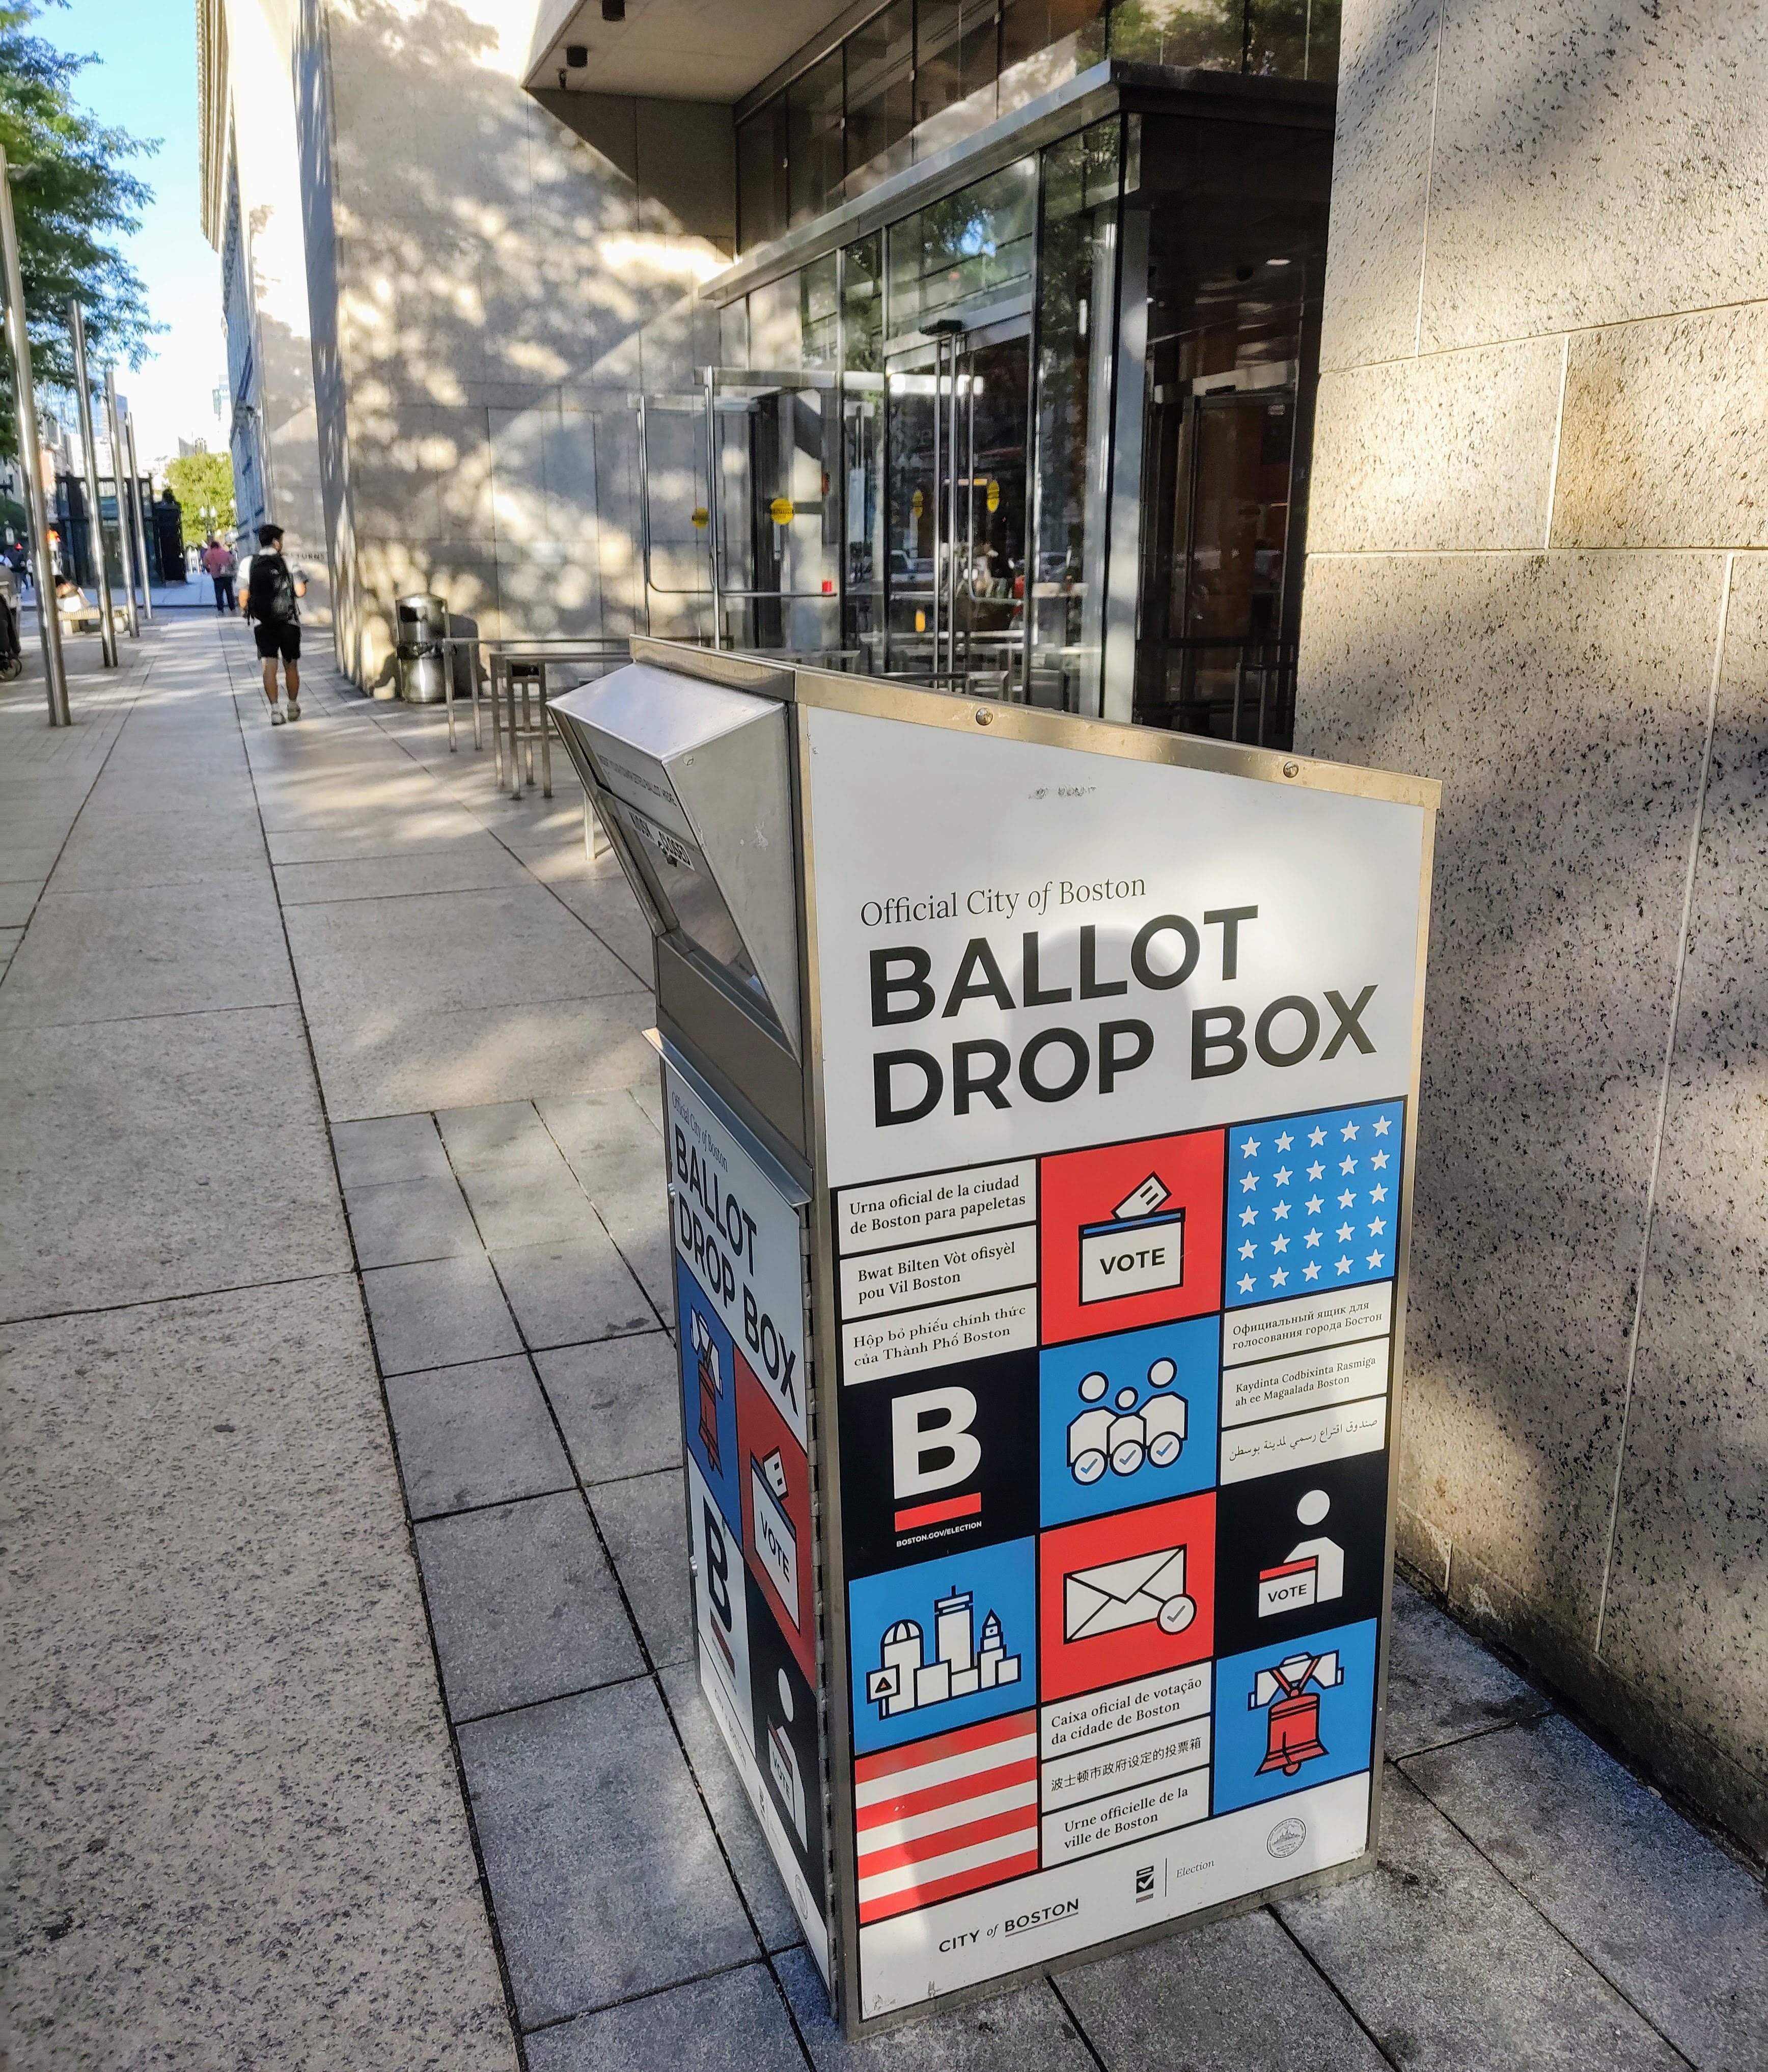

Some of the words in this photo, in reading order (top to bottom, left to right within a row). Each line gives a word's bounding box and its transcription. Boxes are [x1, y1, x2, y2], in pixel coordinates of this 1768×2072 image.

[658, 831, 692, 866] CLOSED
[861, 892, 958, 926] Official
[967, 888, 1020, 919] City
[1028, 881, 1053, 916] of
[1060, 878, 1146, 904] Boston
[869, 904, 1259, 1027] BALLOT
[873, 1018, 1155, 1128] DROP
[1191, 984, 1379, 1081] BOX
[672, 1091, 689, 1125] Official
[690, 1113, 701, 1144] City
[702, 1130, 707, 1152] of
[708, 1134, 728, 1173] Boston
[675, 1123, 757, 1277] BALLOT
[850, 1201, 885, 1215] Urna
[890, 1189, 933, 1209] oficial
[937, 1187, 953, 1200] de
[958, 1184, 970, 1196] la
[974, 1174, 1019, 1194] ciudad
[850, 1221, 867, 1234] de
[872, 1213, 921, 1231] Boston
[925, 1207, 956, 1225] para
[960, 1194, 1026, 1219] papeletas
[858, 1265, 894, 1282] Bwat
[898, 1258, 940, 1275] Bilten
[944, 1251, 967, 1265] Vòt
[971, 1241, 1016, 1261] ofisyèl
[1099, 1247, 1165, 1276] VOTE
[679, 1191, 735, 1310] DROP
[742, 1282, 799, 1418] BOX
[858, 1287, 885, 1305] pou
[889, 1280, 908, 1295] Vil
[913, 1273, 961, 1290] Boston
[853, 1334, 884, 1349] Hộp
[888, 1327, 905, 1341] bỏ
[909, 1317, 949, 1340] phiếu
[953, 1312, 990, 1328] chính
[994, 1305, 1026, 1320] thức
[1232, 1330, 1303, 1350] голосования
[1306, 1322, 1342, 1337] города
[1345, 1313, 1383, 1327] Бостон
[1233, 1310, 1314, 1336] Официальный
[1317, 1306, 1346, 1319] ящик
[1349, 1302, 1370, 1313] для
[854, 1352, 879, 1367] của
[883, 1340, 928, 1361] Thành
[932, 1332, 959, 1350] Phố
[963, 1328, 1011, 1344] Boston
[1235, 1396, 1247, 1406] ah
[1250, 1395, 1261, 1403] ee
[1264, 1383, 1314, 1400] Magaalada
[1317, 1376, 1350, 1389] Boston
[1236, 1376, 1279, 1393] Kaydinta
[1282, 1367, 1334, 1383] Codbixinta
[1337, 1357, 1376, 1372] Rasmiga
[892, 1386, 982, 1500] B
[1290, 1434, 1317, 1450] رسمي
[1319, 1424, 1343, 1443] اقتراع
[1346, 1419, 1378, 1433] صندوق
[760, 1510, 790, 1584] VOTE
[896, 1521, 982, 1548] BOSTON.GOV/ELECTION
[703, 1495, 732, 1633] B
[1268, 1584, 1307, 1603] VOTE
[1052, 1711, 1087, 1728] Caixa
[1091, 1696, 1130, 1717] oficial
[1135, 1692, 1150, 1705] de
[1153, 1678, 1202, 1699] votação
[1052, 1733, 1066, 1745] da
[1070, 1720, 1113, 1739] cidade
[1117, 1714, 1132, 1726] de
[1137, 1701, 1180, 1721] Boston
[772, 1751, 791, 1802] VOTE
[1051, 1736, 1202, 1792] 波士顿市政府设定的投票箱
[1064, 1815, 1097, 1833] Urne
[1100, 1797, 1156, 1822] officielle
[1159, 1791, 1174, 1804] de
[1178, 1787, 1189, 1799] la
[1064, 1834, 1092, 1849] ville
[1095, 1827, 1111, 1840] de
[1115, 1813, 1158, 1834] Boston
[1176, 1860, 1215, 1878] Election
[938, 1929, 980, 1953] CITY
[986, 1923, 999, 1938] of
[1005, 1898, 1080, 1933] BOSTON
